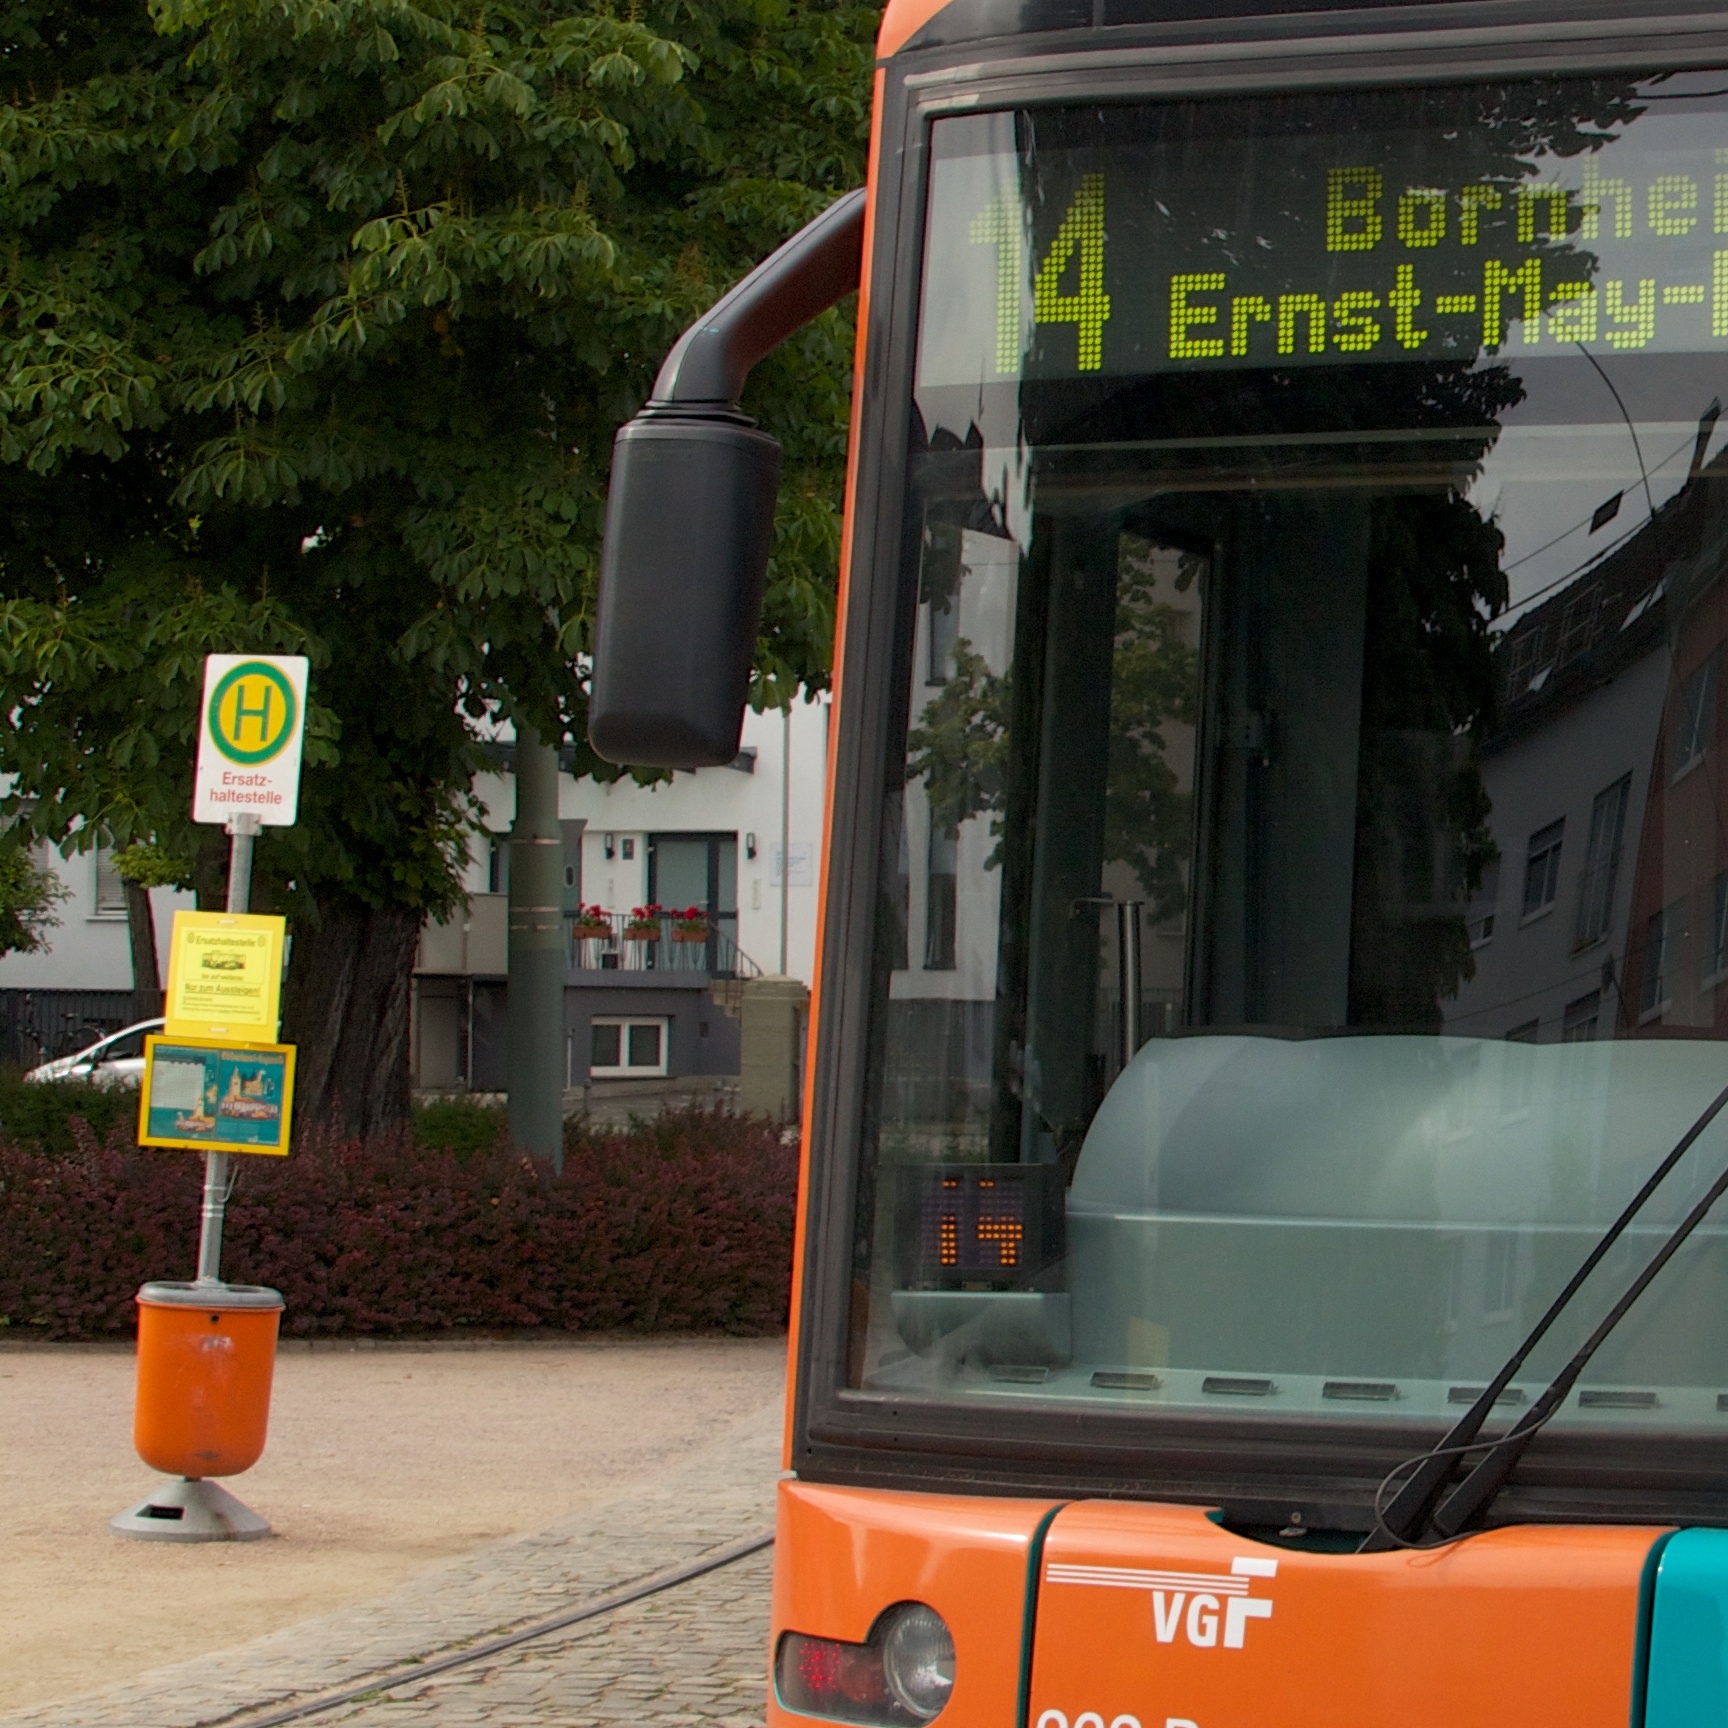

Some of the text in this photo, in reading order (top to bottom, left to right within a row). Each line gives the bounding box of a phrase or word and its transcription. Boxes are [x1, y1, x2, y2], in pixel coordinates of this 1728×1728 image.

[968, 173, 1110, 373] 14
[209, 789, 283, 805] haltestelle
[222, 772, 273, 787] Ersatz-
[1152, 1557, 1278, 1649] VGF
